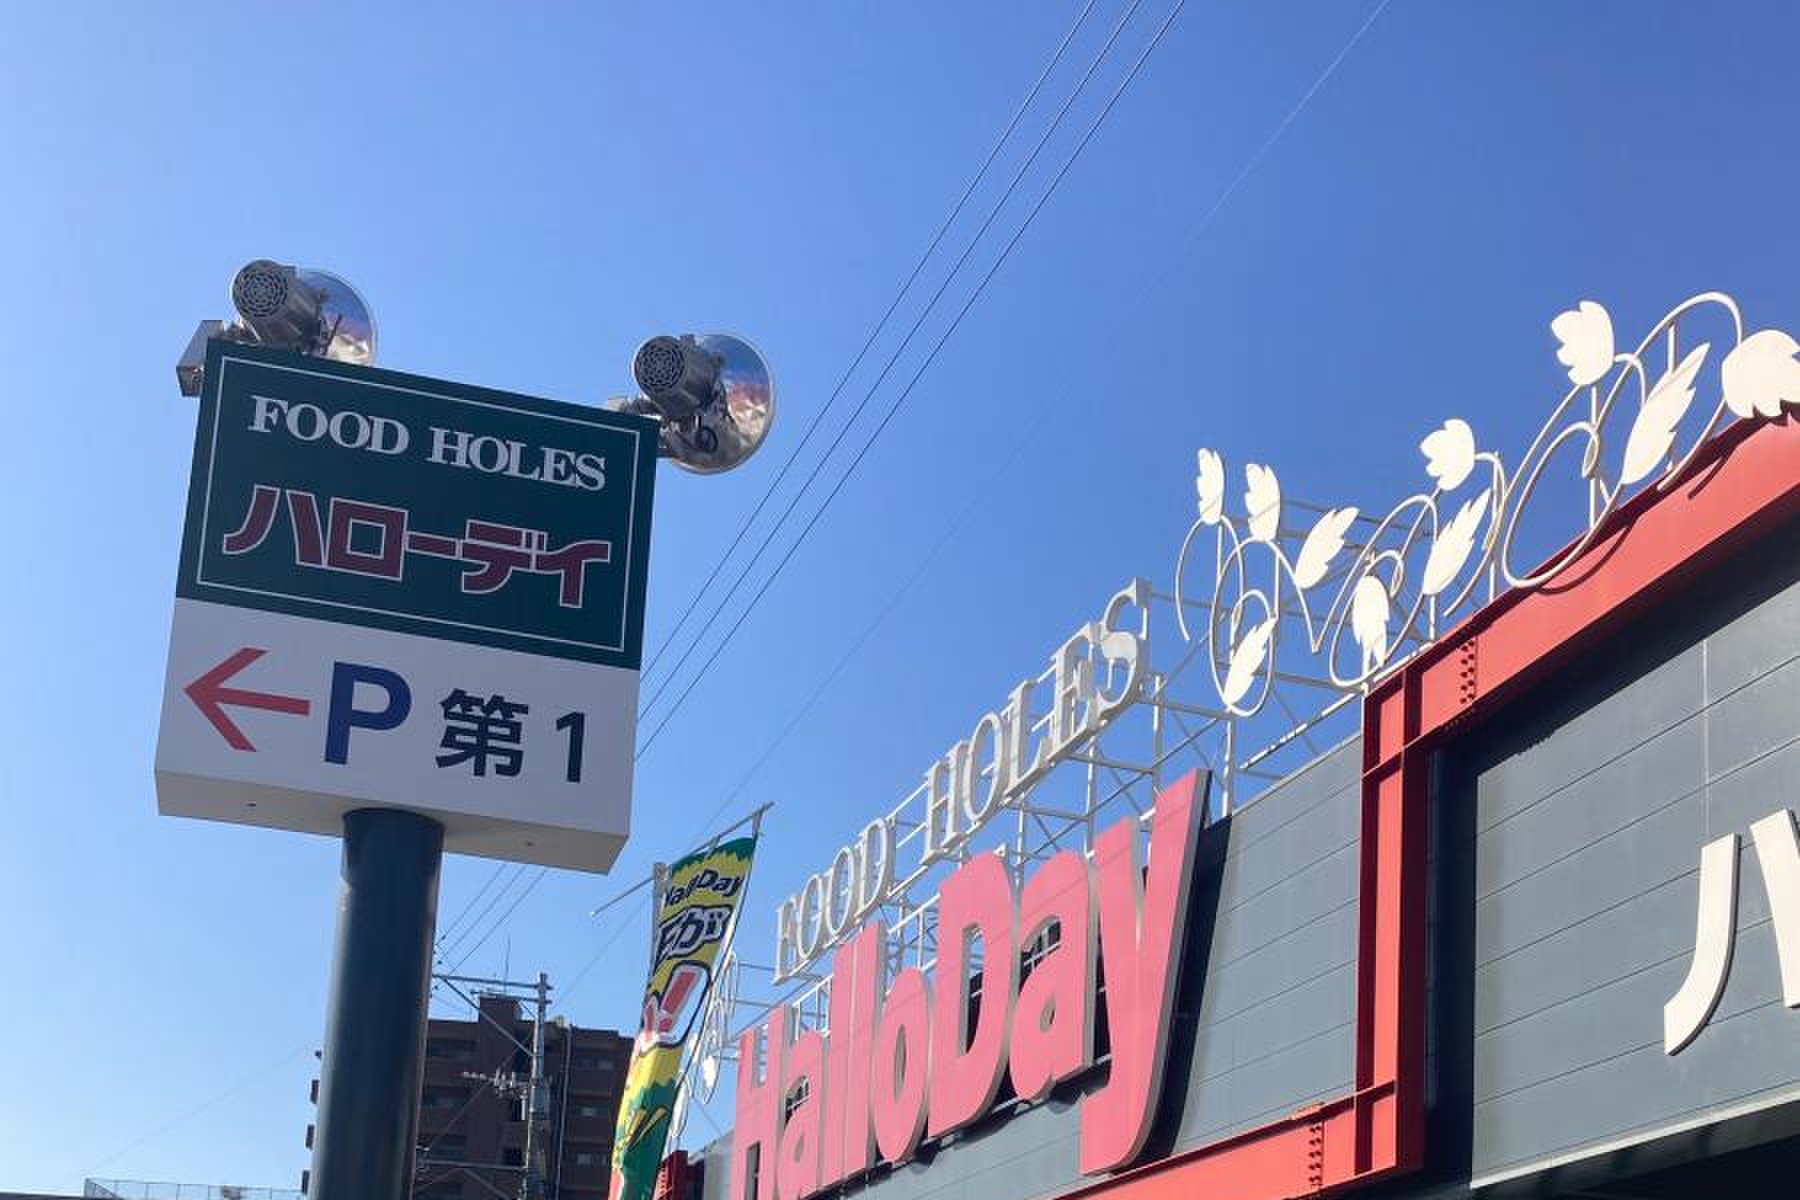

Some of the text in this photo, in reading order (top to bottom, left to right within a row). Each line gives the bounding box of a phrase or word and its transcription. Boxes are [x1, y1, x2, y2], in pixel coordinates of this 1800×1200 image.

[247, 395, 606, 491] FOOD HOLES
[323, 659, 586, 784] P 第1
[773, 816, 896, 985] FOOD
[921, 577, 1152, 865] HOLES
